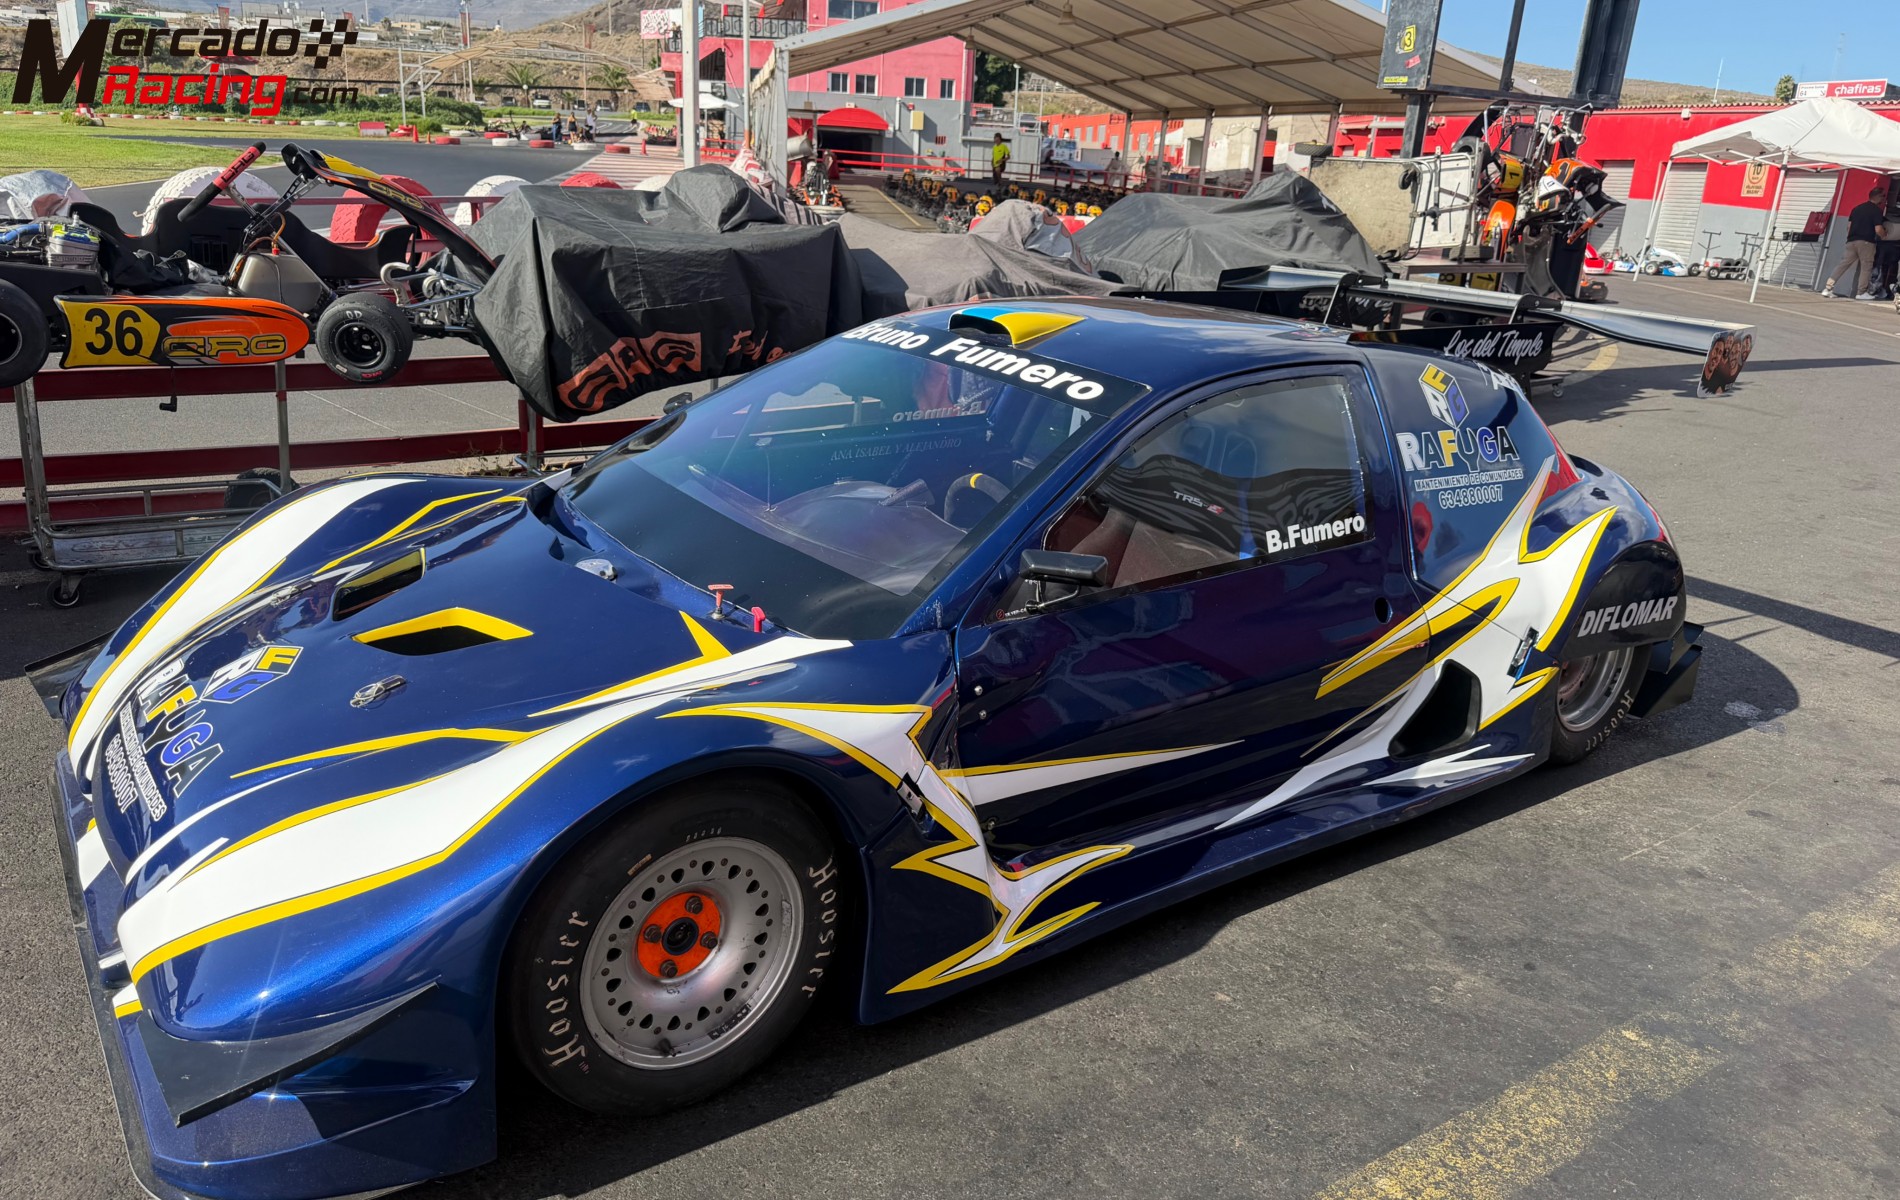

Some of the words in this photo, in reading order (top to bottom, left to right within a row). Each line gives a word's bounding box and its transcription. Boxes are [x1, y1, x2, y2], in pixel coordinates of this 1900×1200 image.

[367, 180, 425, 210] CRG
[85, 308, 143, 356] 36
[161, 334, 288, 358] CRG
[1443, 330, 1475, 358] Los
[1471, 331, 1502, 358] del
[841, 322, 931, 351] Bruno
[929, 337, 1105, 401] Fumero
[855, 445, 892, 459] ISABEL
[1396, 425, 1520, 473] RAFUGA
[1414, 475, 1469, 491] MANTENIMIENTO
[1480, 468, 1524, 483] COMUNIDADES
[1438, 484, 1503, 510] 634880007
[1265, 515, 1365, 553] B.Fumero
[1577, 596, 1678, 638] DIFLOMAR
[542, 911, 589, 1067] Hoosier
